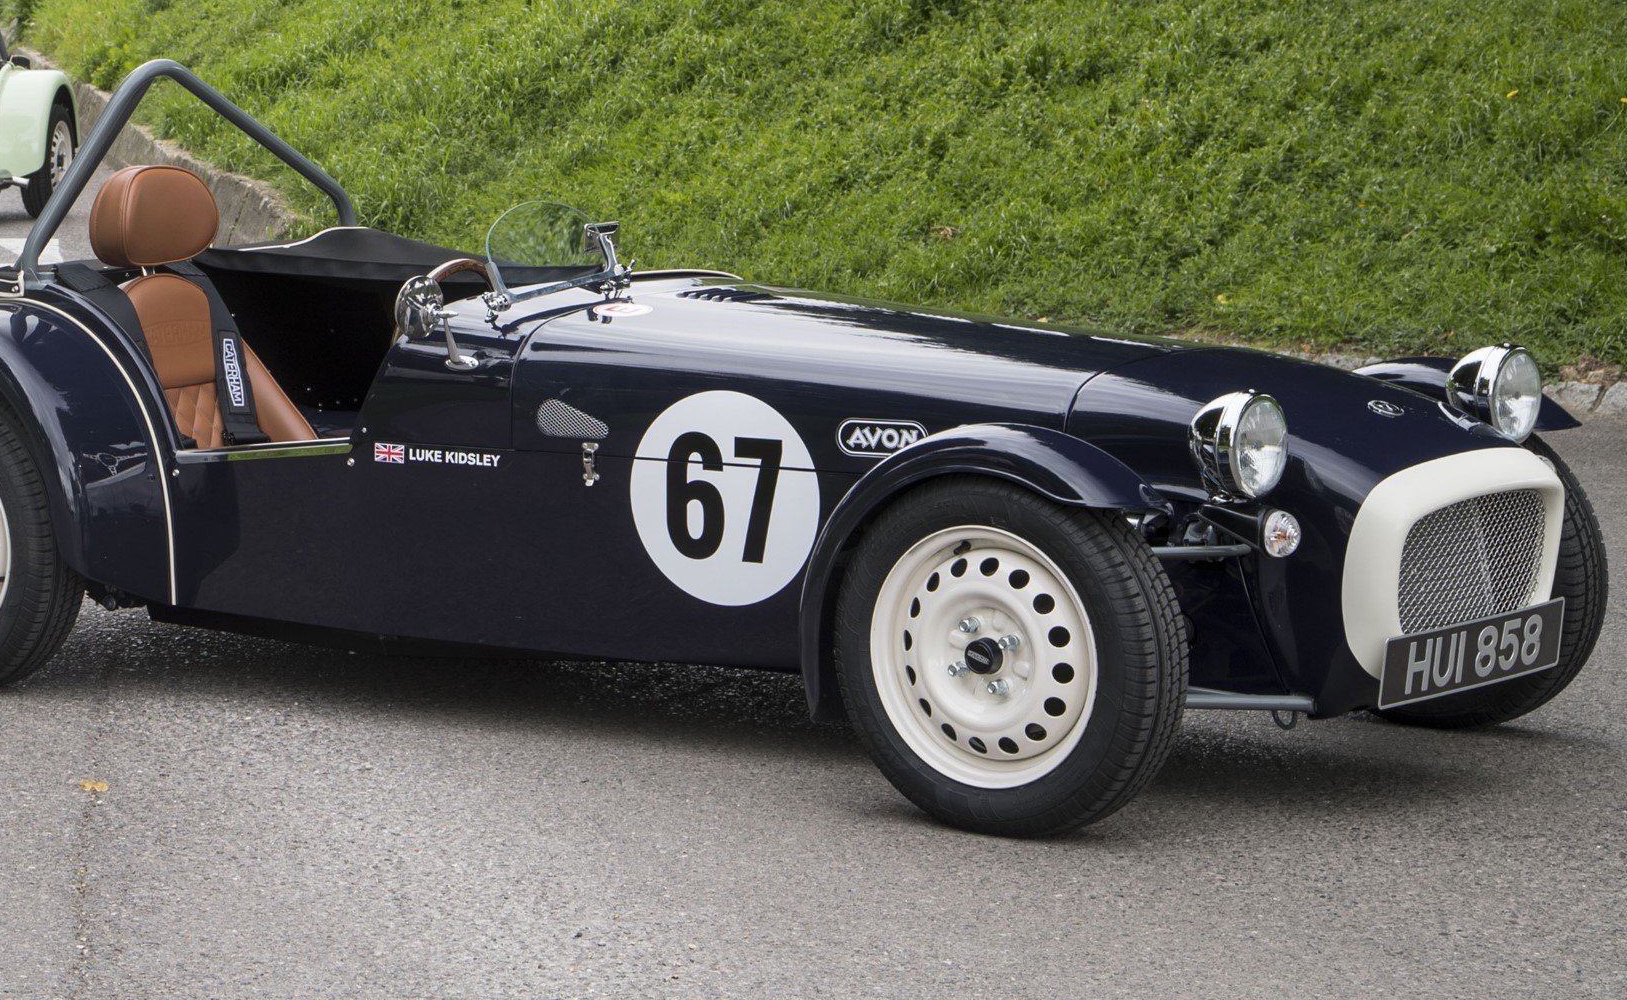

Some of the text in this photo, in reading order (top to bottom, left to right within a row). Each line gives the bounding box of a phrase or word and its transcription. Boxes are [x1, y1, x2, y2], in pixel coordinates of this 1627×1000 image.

[224, 339, 244, 406] CATERHAM
[409, 448, 501, 468] LUKE KIDSLEY
[846, 425, 919, 450] AVON
[666, 430, 784, 565] 67
[1404, 613, 1543, 695] HUI 858
